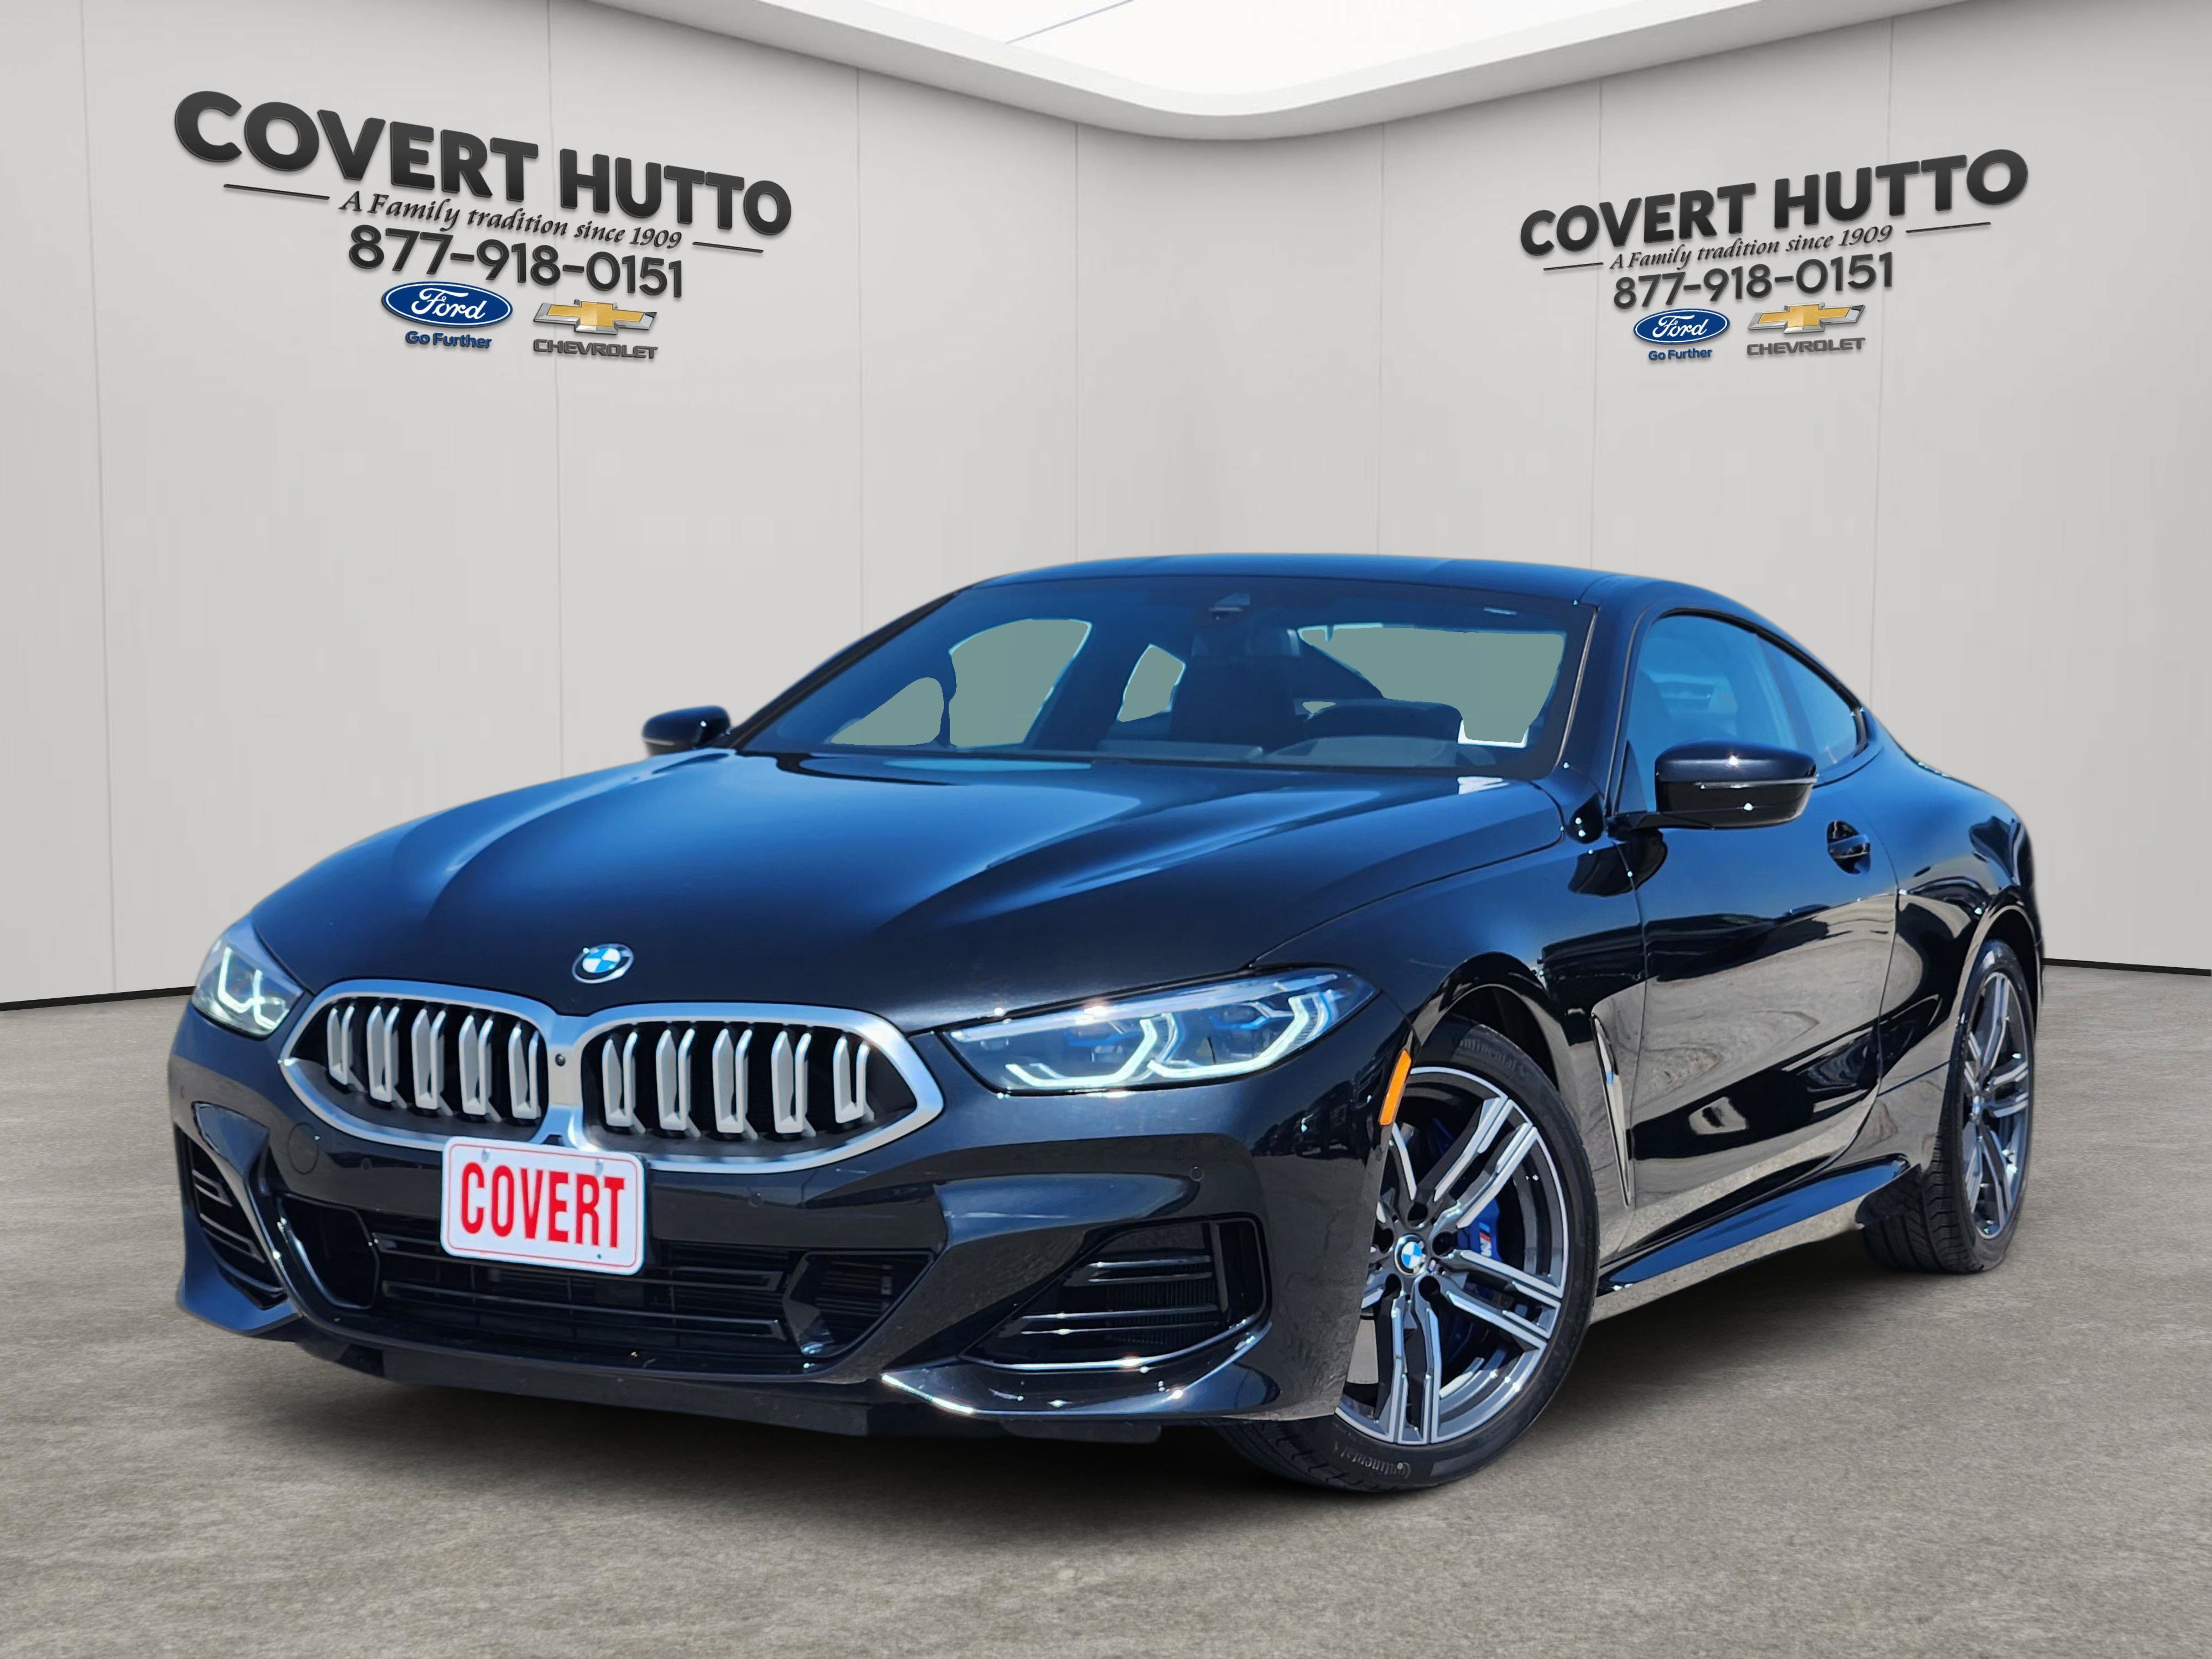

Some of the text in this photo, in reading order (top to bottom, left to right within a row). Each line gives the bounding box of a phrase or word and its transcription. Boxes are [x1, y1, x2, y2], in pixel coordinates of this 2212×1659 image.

[175, 91, 791, 237] COVERT HUTTO
[338, 191, 682, 249] A Family tradition since 1909
[1521, 149, 2028, 256] COVERT HUTTO
[349, 225, 681, 299] 877-918-0151
[1609, 225, 1893, 270] A Family tradition since 1909
[1614, 252, 1892, 310] 877-918-0151
[411, 288, 488, 320] Ford
[1652, 315, 1709, 338] Ford
[405, 331, 492, 349] Go Further
[533, 338, 659, 359] CHEVROLET
[1648, 348, 1713, 361] Go Further
[1746, 337, 1866, 356] CHEVROLET
[461, 1161, 625, 1249] COVERT
